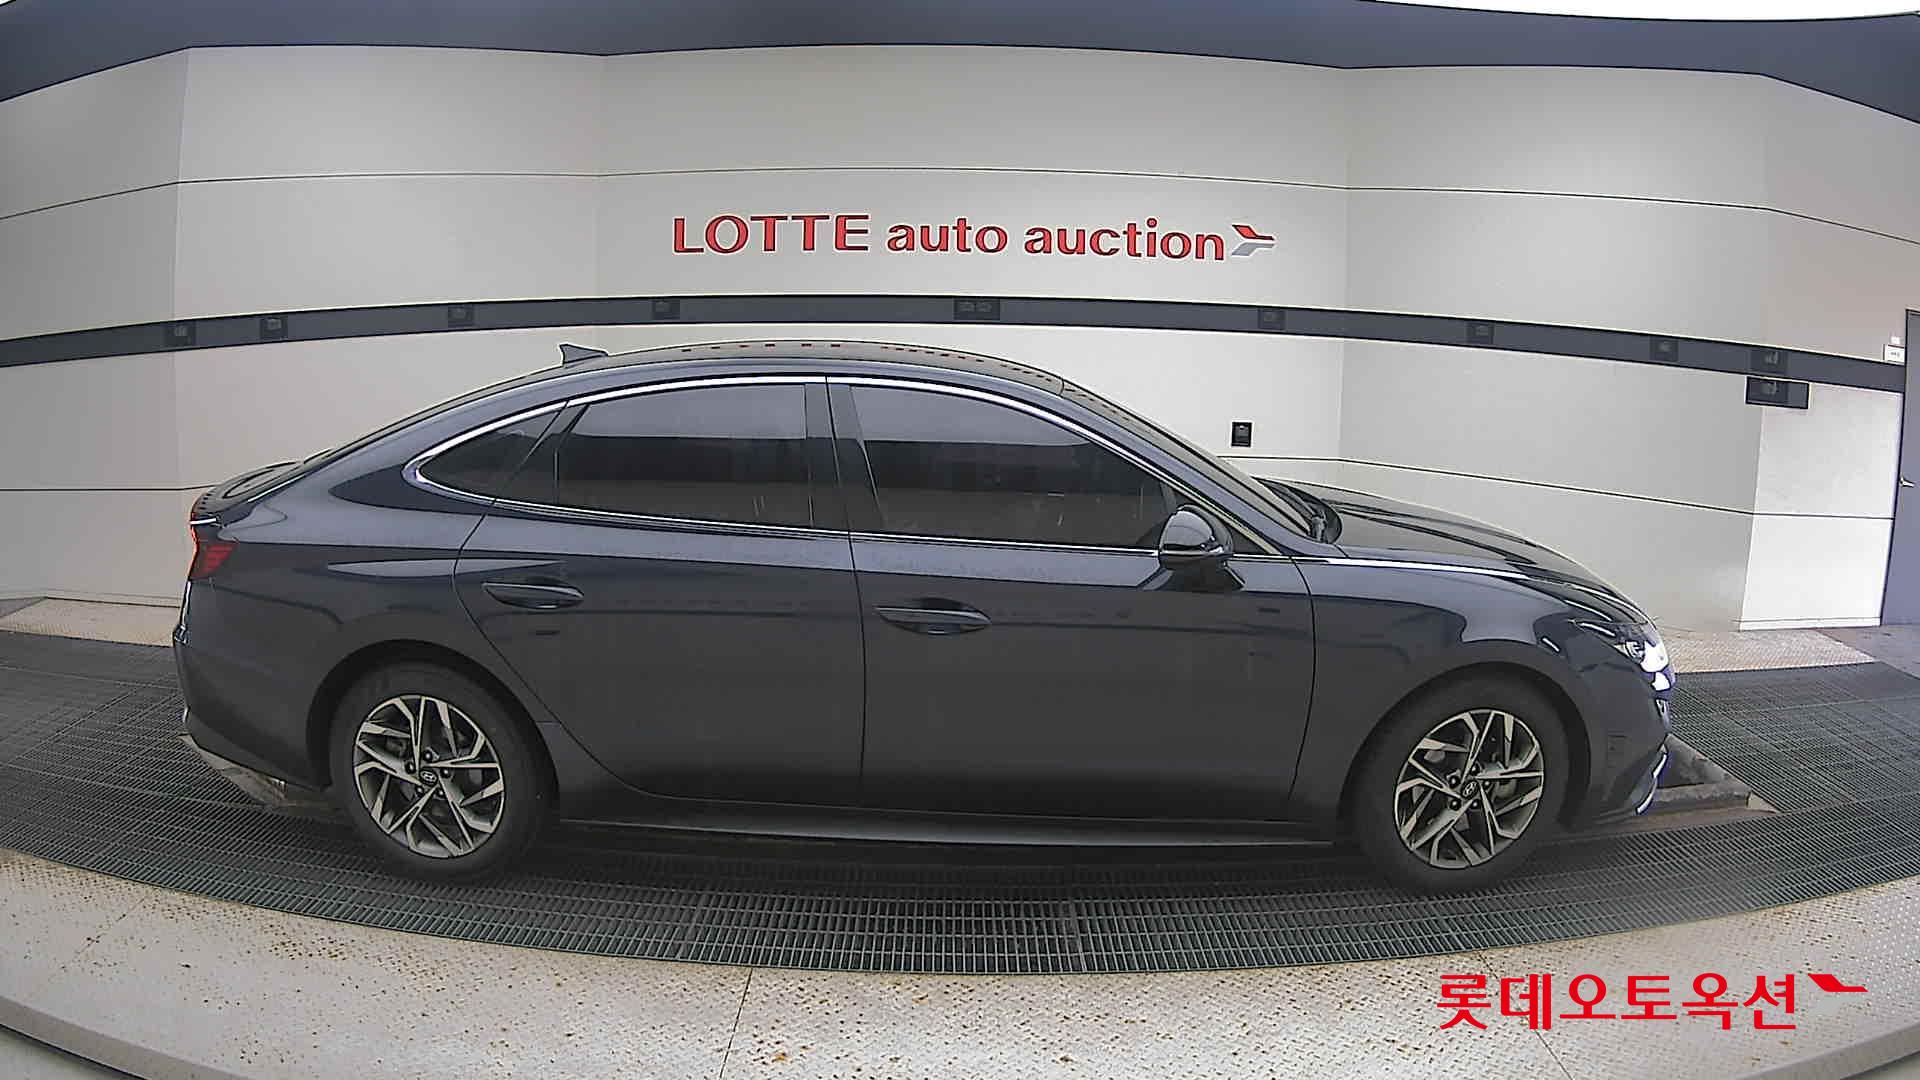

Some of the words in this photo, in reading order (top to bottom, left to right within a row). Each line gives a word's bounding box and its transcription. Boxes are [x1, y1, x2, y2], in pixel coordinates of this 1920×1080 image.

[673, 214, 870, 254] LOTTE
[886, 217, 1008, 254] auto
[1024, 218, 1226, 261] auction
